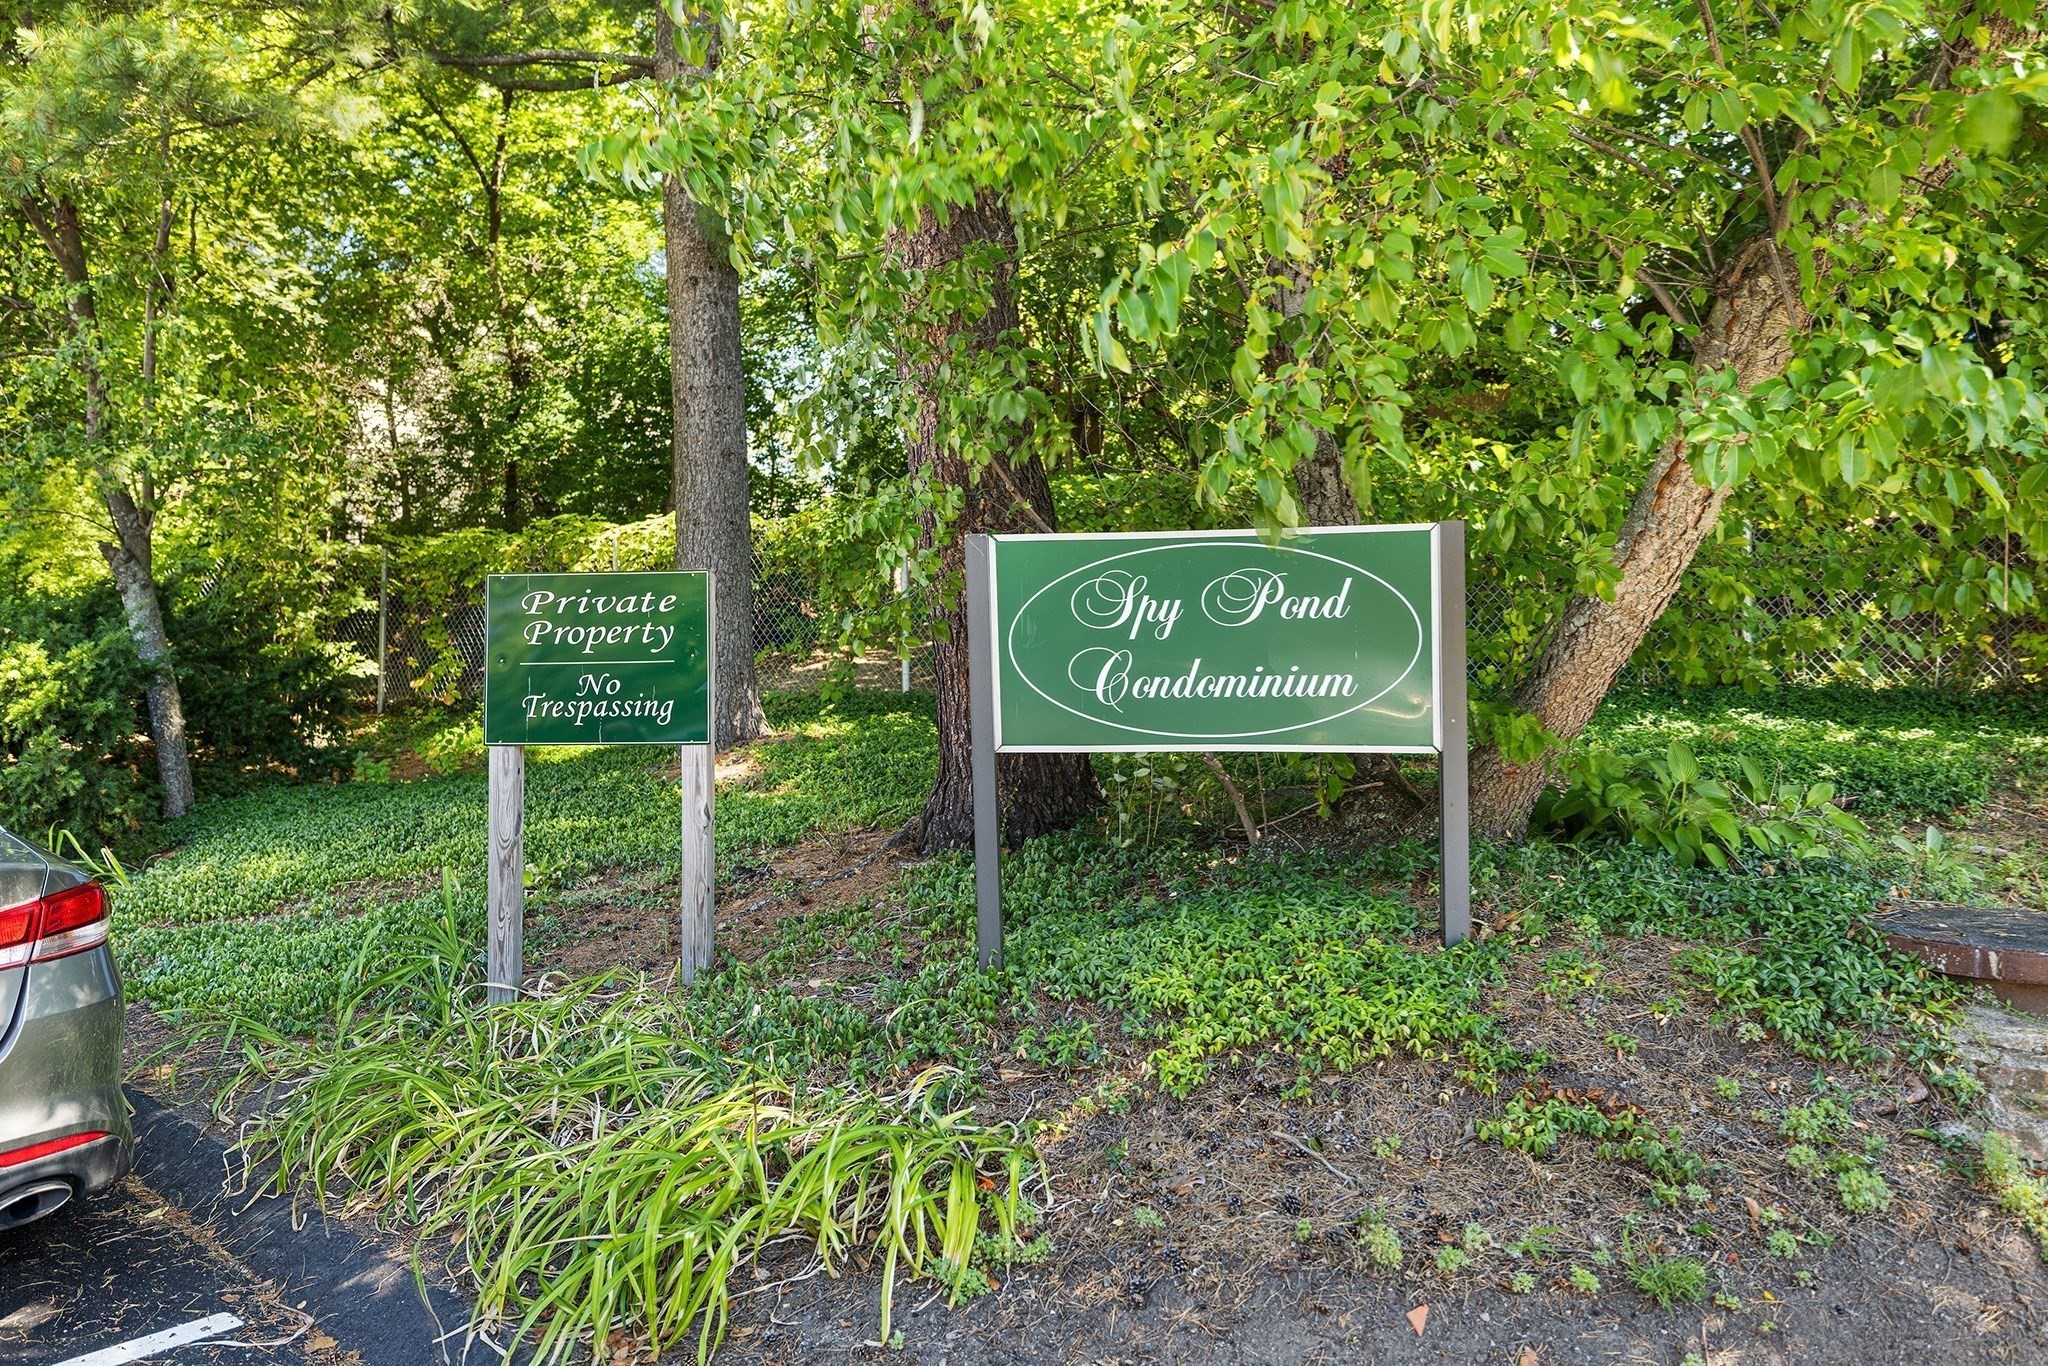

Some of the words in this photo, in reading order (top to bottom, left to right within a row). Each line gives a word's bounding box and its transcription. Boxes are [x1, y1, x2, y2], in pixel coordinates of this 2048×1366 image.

[521, 588, 677, 615] Private
[1070, 569, 1184, 640] Spy
[1200, 567, 1353, 627] Pond
[523, 620, 675, 654] Property
[575, 673, 621, 697] No
[1067, 646, 1359, 714] Condominium
[521, 693, 675, 726] Trespassing
